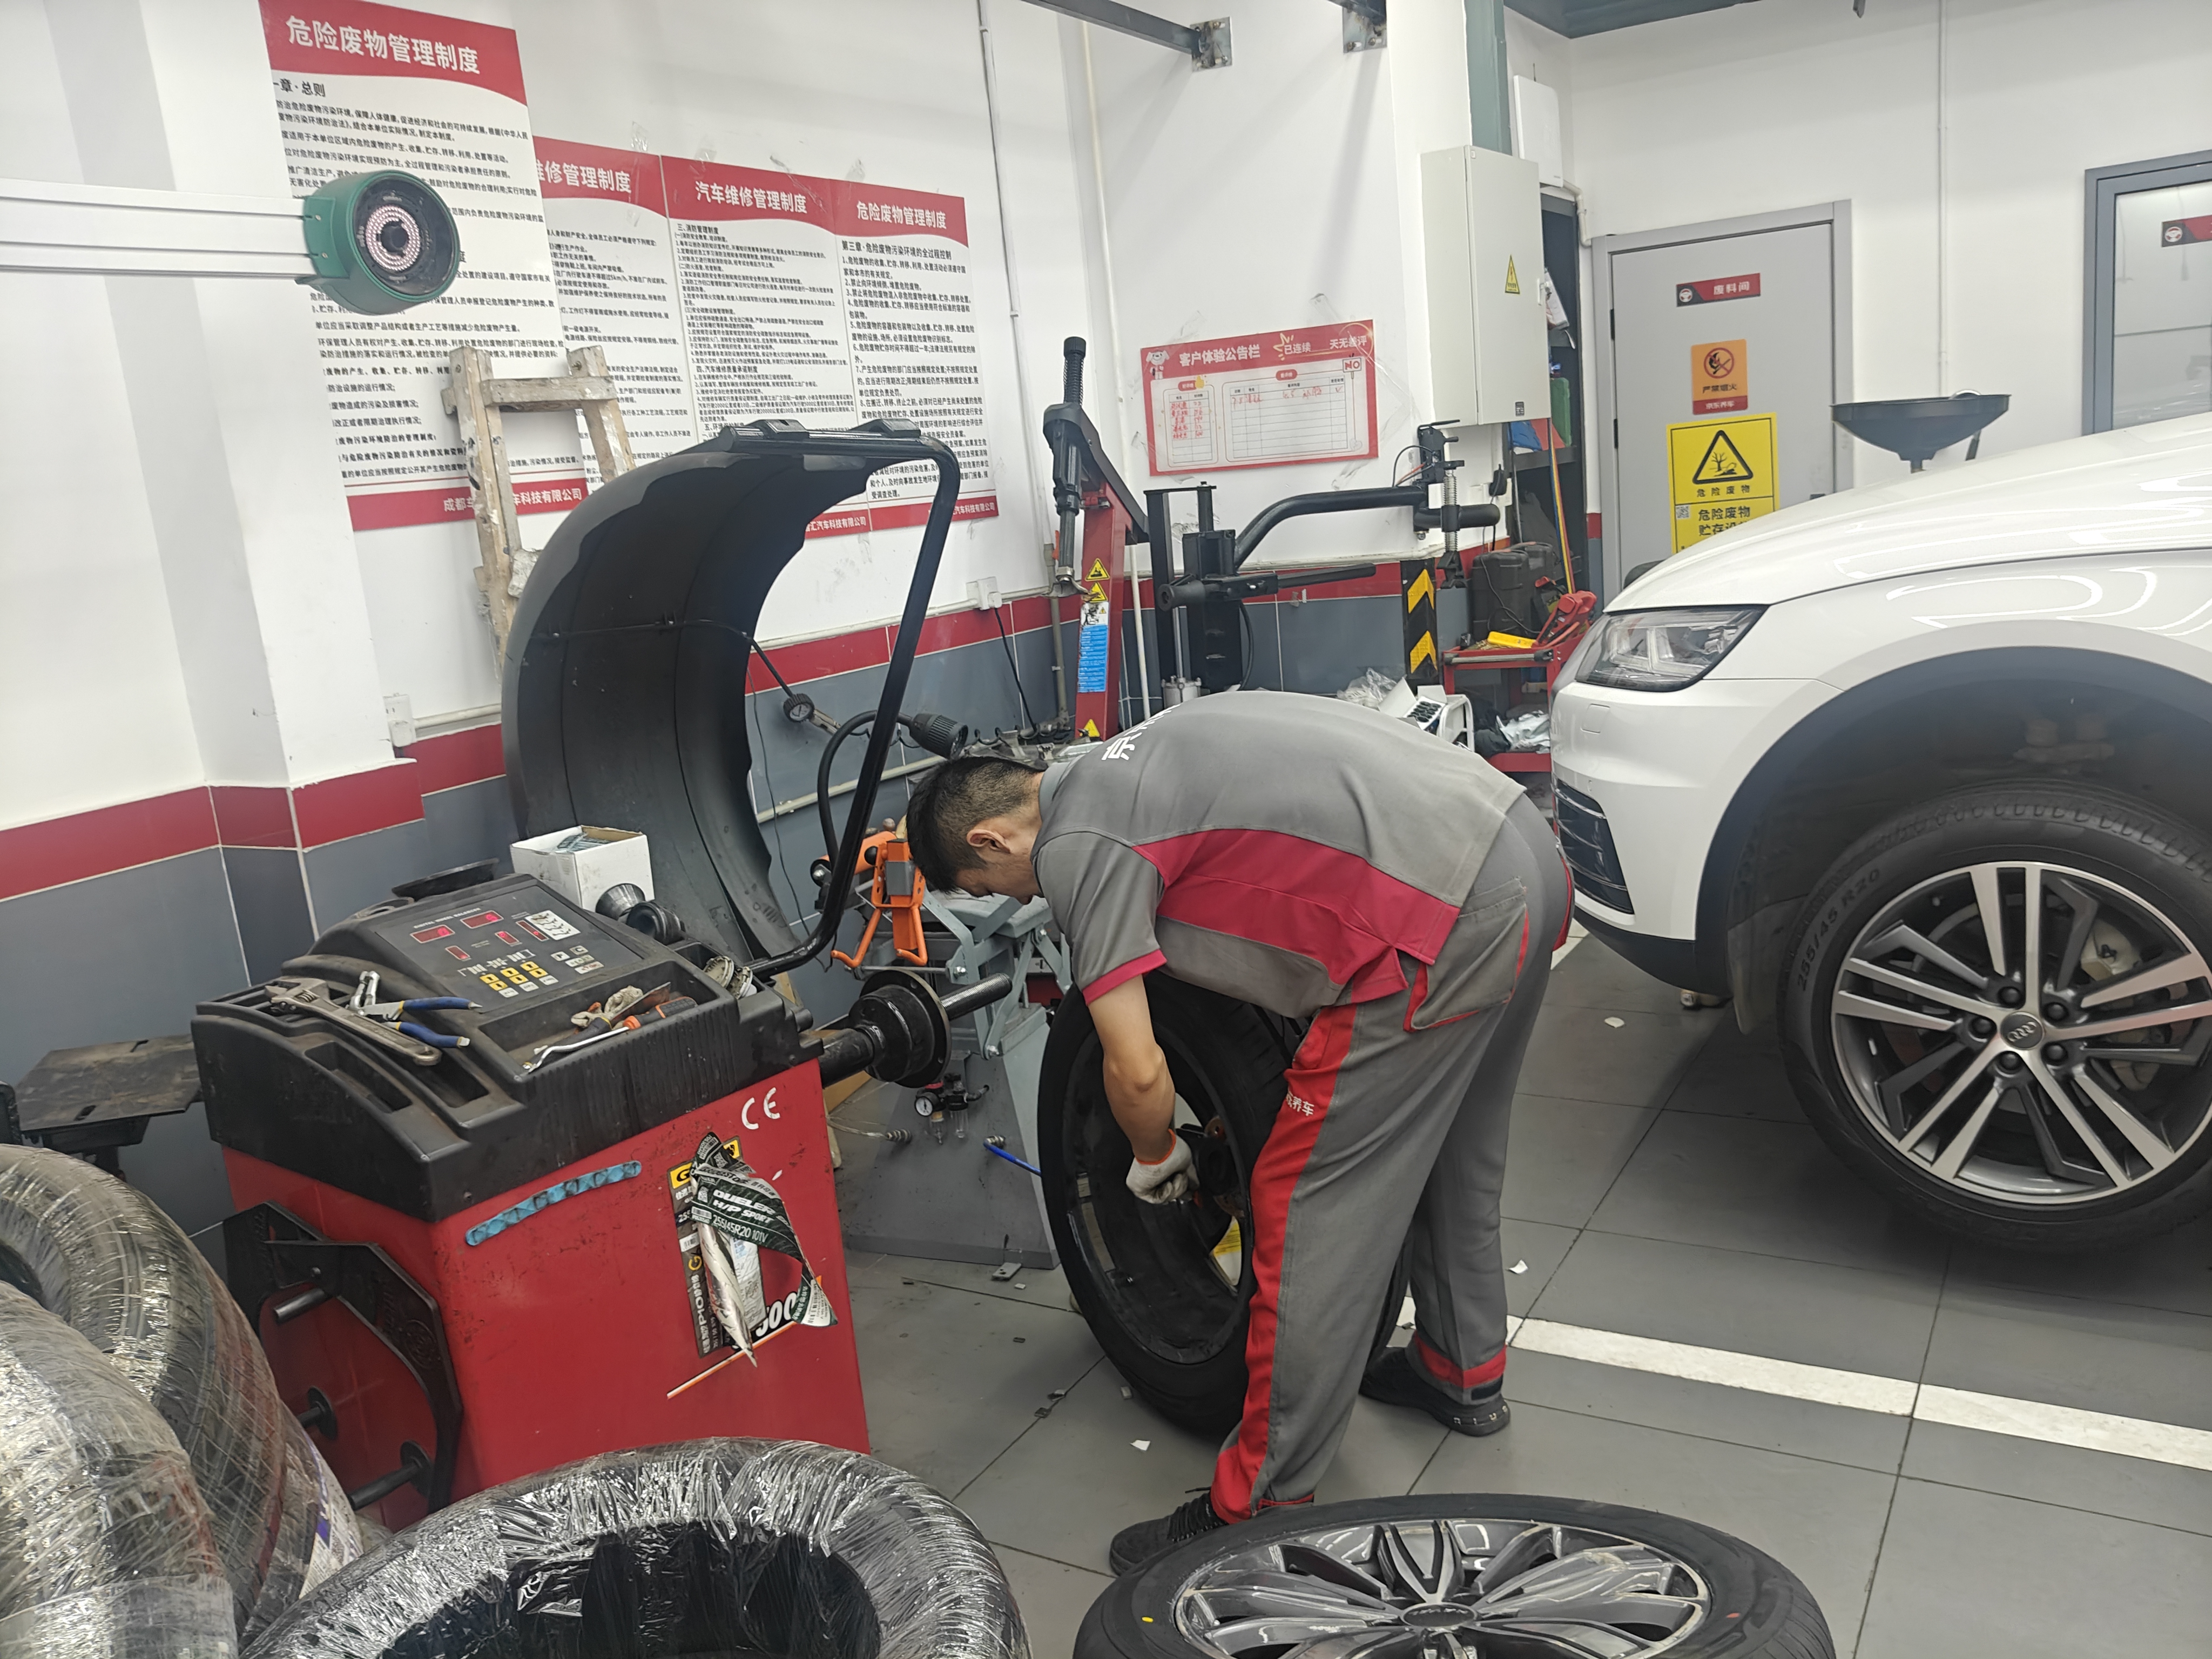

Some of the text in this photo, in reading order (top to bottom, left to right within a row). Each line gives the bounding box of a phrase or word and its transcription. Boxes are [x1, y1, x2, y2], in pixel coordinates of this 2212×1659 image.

[285, 16, 480, 75] 危险废物管理制度
[694, 180, 807, 214] 汽车维修管理制度
[856, 200, 947, 230] 危险废物管理制度
[1714, 281, 1750, 295] 废料间
[1179, 343, 1261, 367] 客户体验公告栏
[1284, 342, 1311, 355] 已连续
[1344, 360, 1360, 370] NO
[1697, 484, 1750, 498] 危险废物
[1698, 505, 1751, 522] 危险废物
[741, 1087, 781, 1130] CE
[712, 1189, 777, 1216] DUELER
[712, 1199, 742, 1213] H/P
[740, 1209, 775, 1224] SPORT
[752, 1229, 769, 1243] 101V
